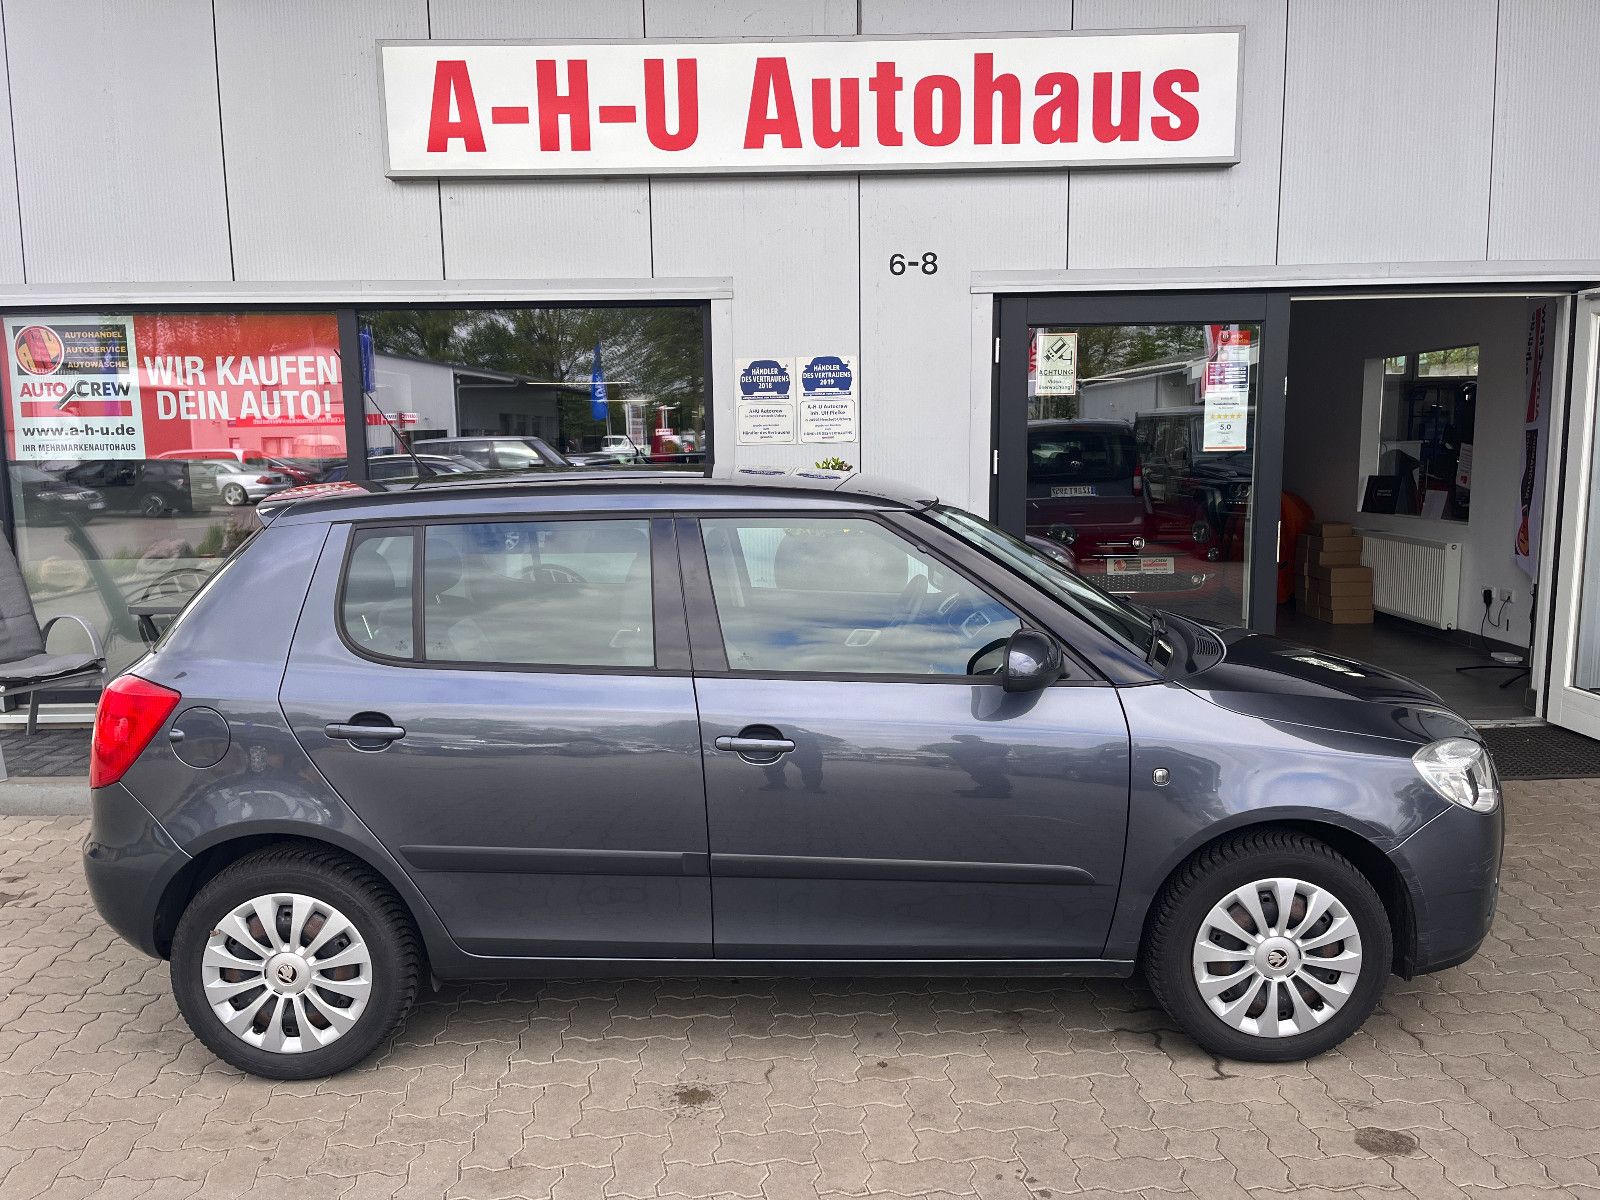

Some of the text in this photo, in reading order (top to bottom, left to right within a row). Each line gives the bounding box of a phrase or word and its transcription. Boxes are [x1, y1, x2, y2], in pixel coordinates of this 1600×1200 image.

[426, 52, 1200, 152] A-H-U Autohaus
[890, 252, 937, 275] 6-8
[64, 331, 122, 339] AUTOHANDEL
[66, 345, 127, 353] AUTOSERVICE
[67, 360, 128, 368] AUTOWÄSCHE
[813, 363, 841, 371] HÄNDLER
[143, 354, 338, 386] WIR KAUFEN
[751, 367, 779, 376] HÄNDLER
[741, 374, 790, 383] DES VERTRAUENS
[819, 378, 835, 386] 2019
[20, 380, 131, 397] AUTO CREW
[156, 390, 332, 421] DEIN AUTO!
[22, 423, 136, 436] www.a-h-u.de
[1219, 423, 1232, 431] 5,0
[22, 443, 136, 452] IHR MEHRMARKENAUTOHAUS
